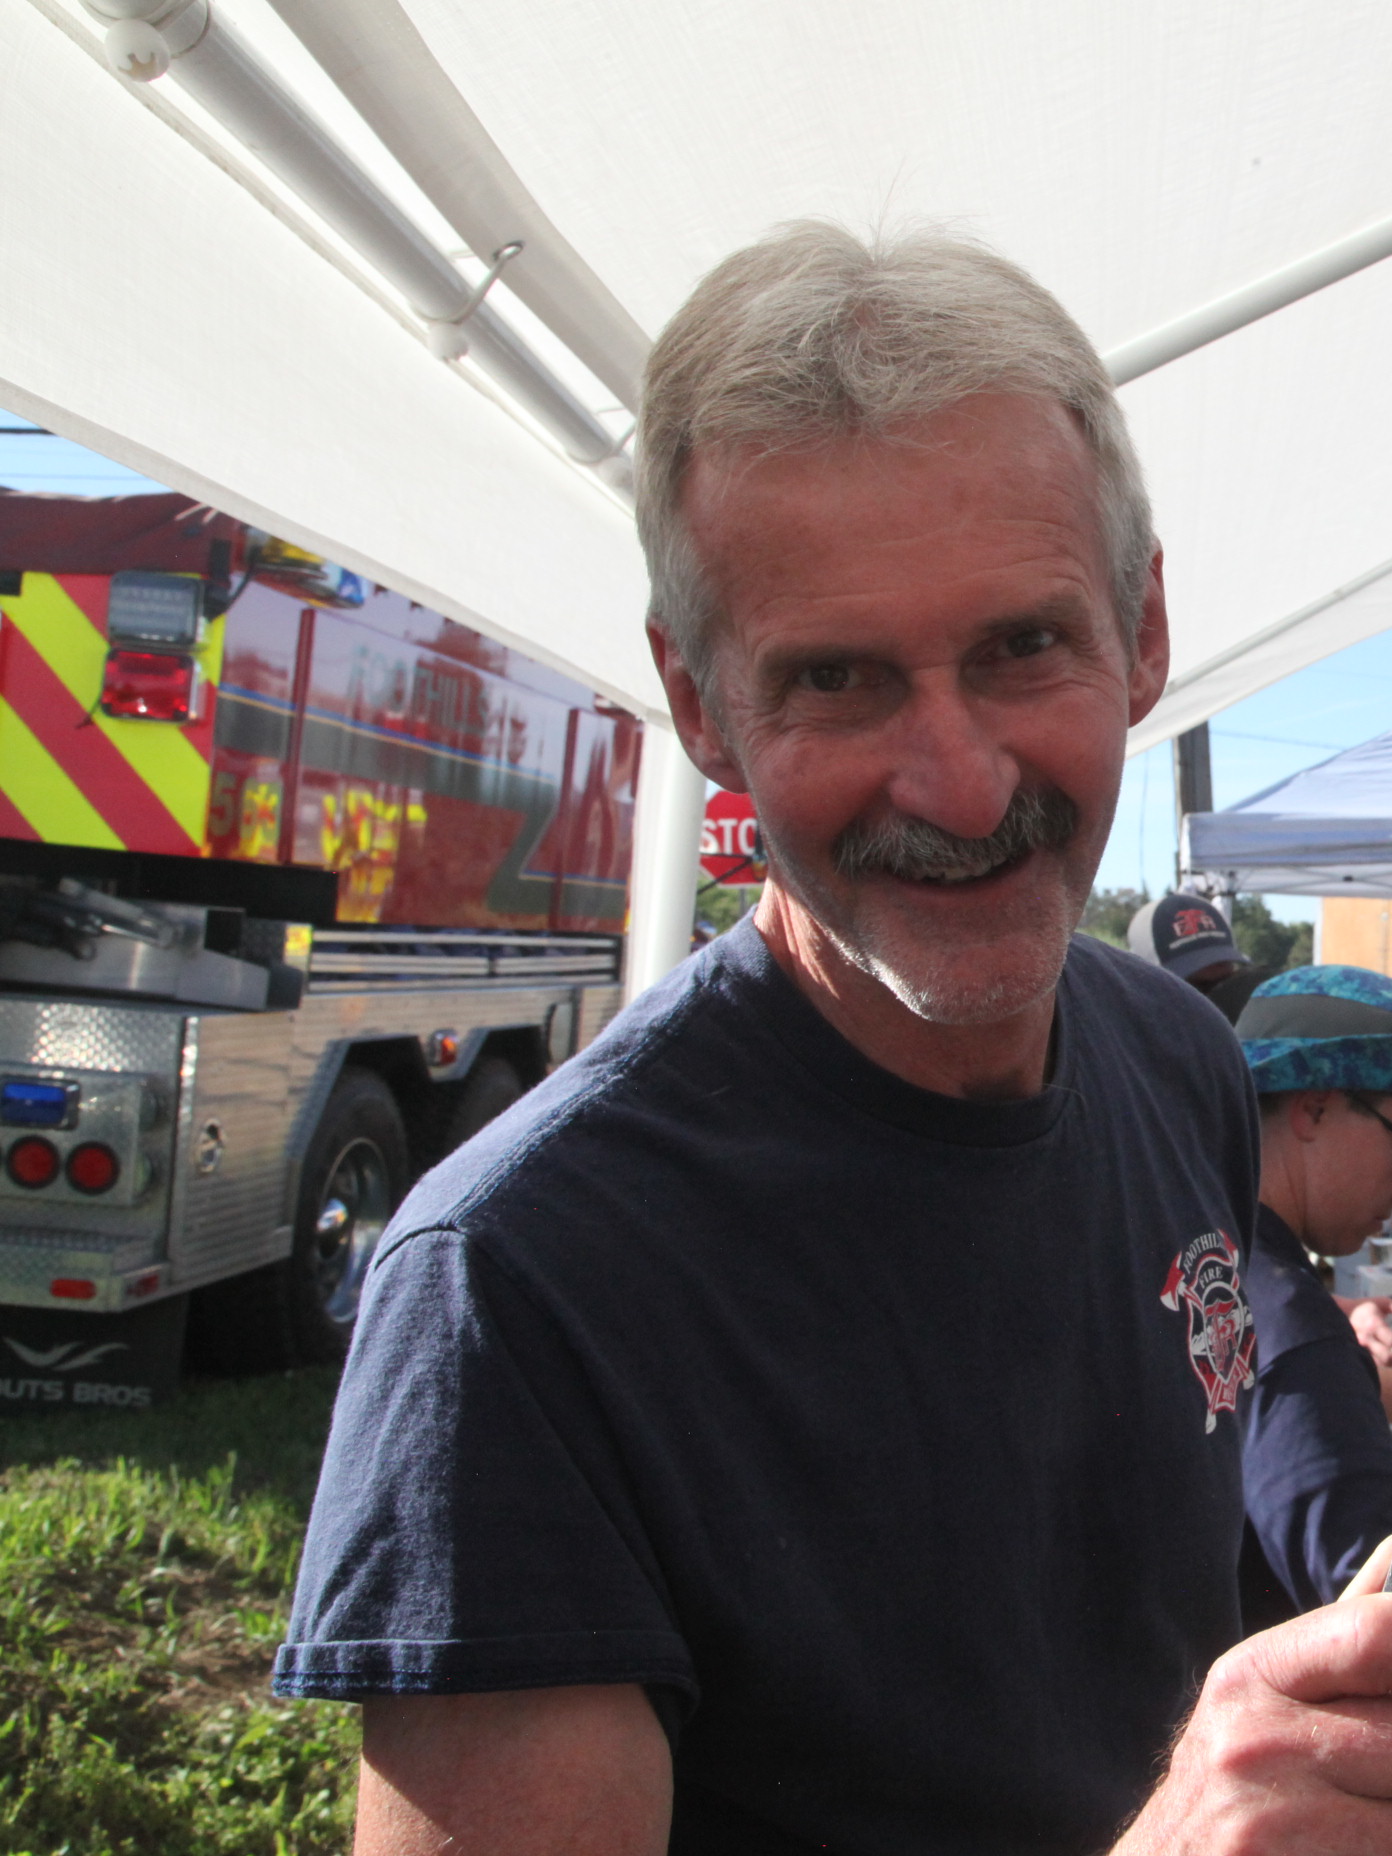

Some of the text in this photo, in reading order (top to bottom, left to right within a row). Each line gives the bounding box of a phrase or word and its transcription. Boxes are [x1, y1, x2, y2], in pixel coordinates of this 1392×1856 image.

[699, 817, 758, 855] STO
[1199, 1266, 1223, 1289] FIRE
[0, 1378, 152, 1407] UTS BROS
